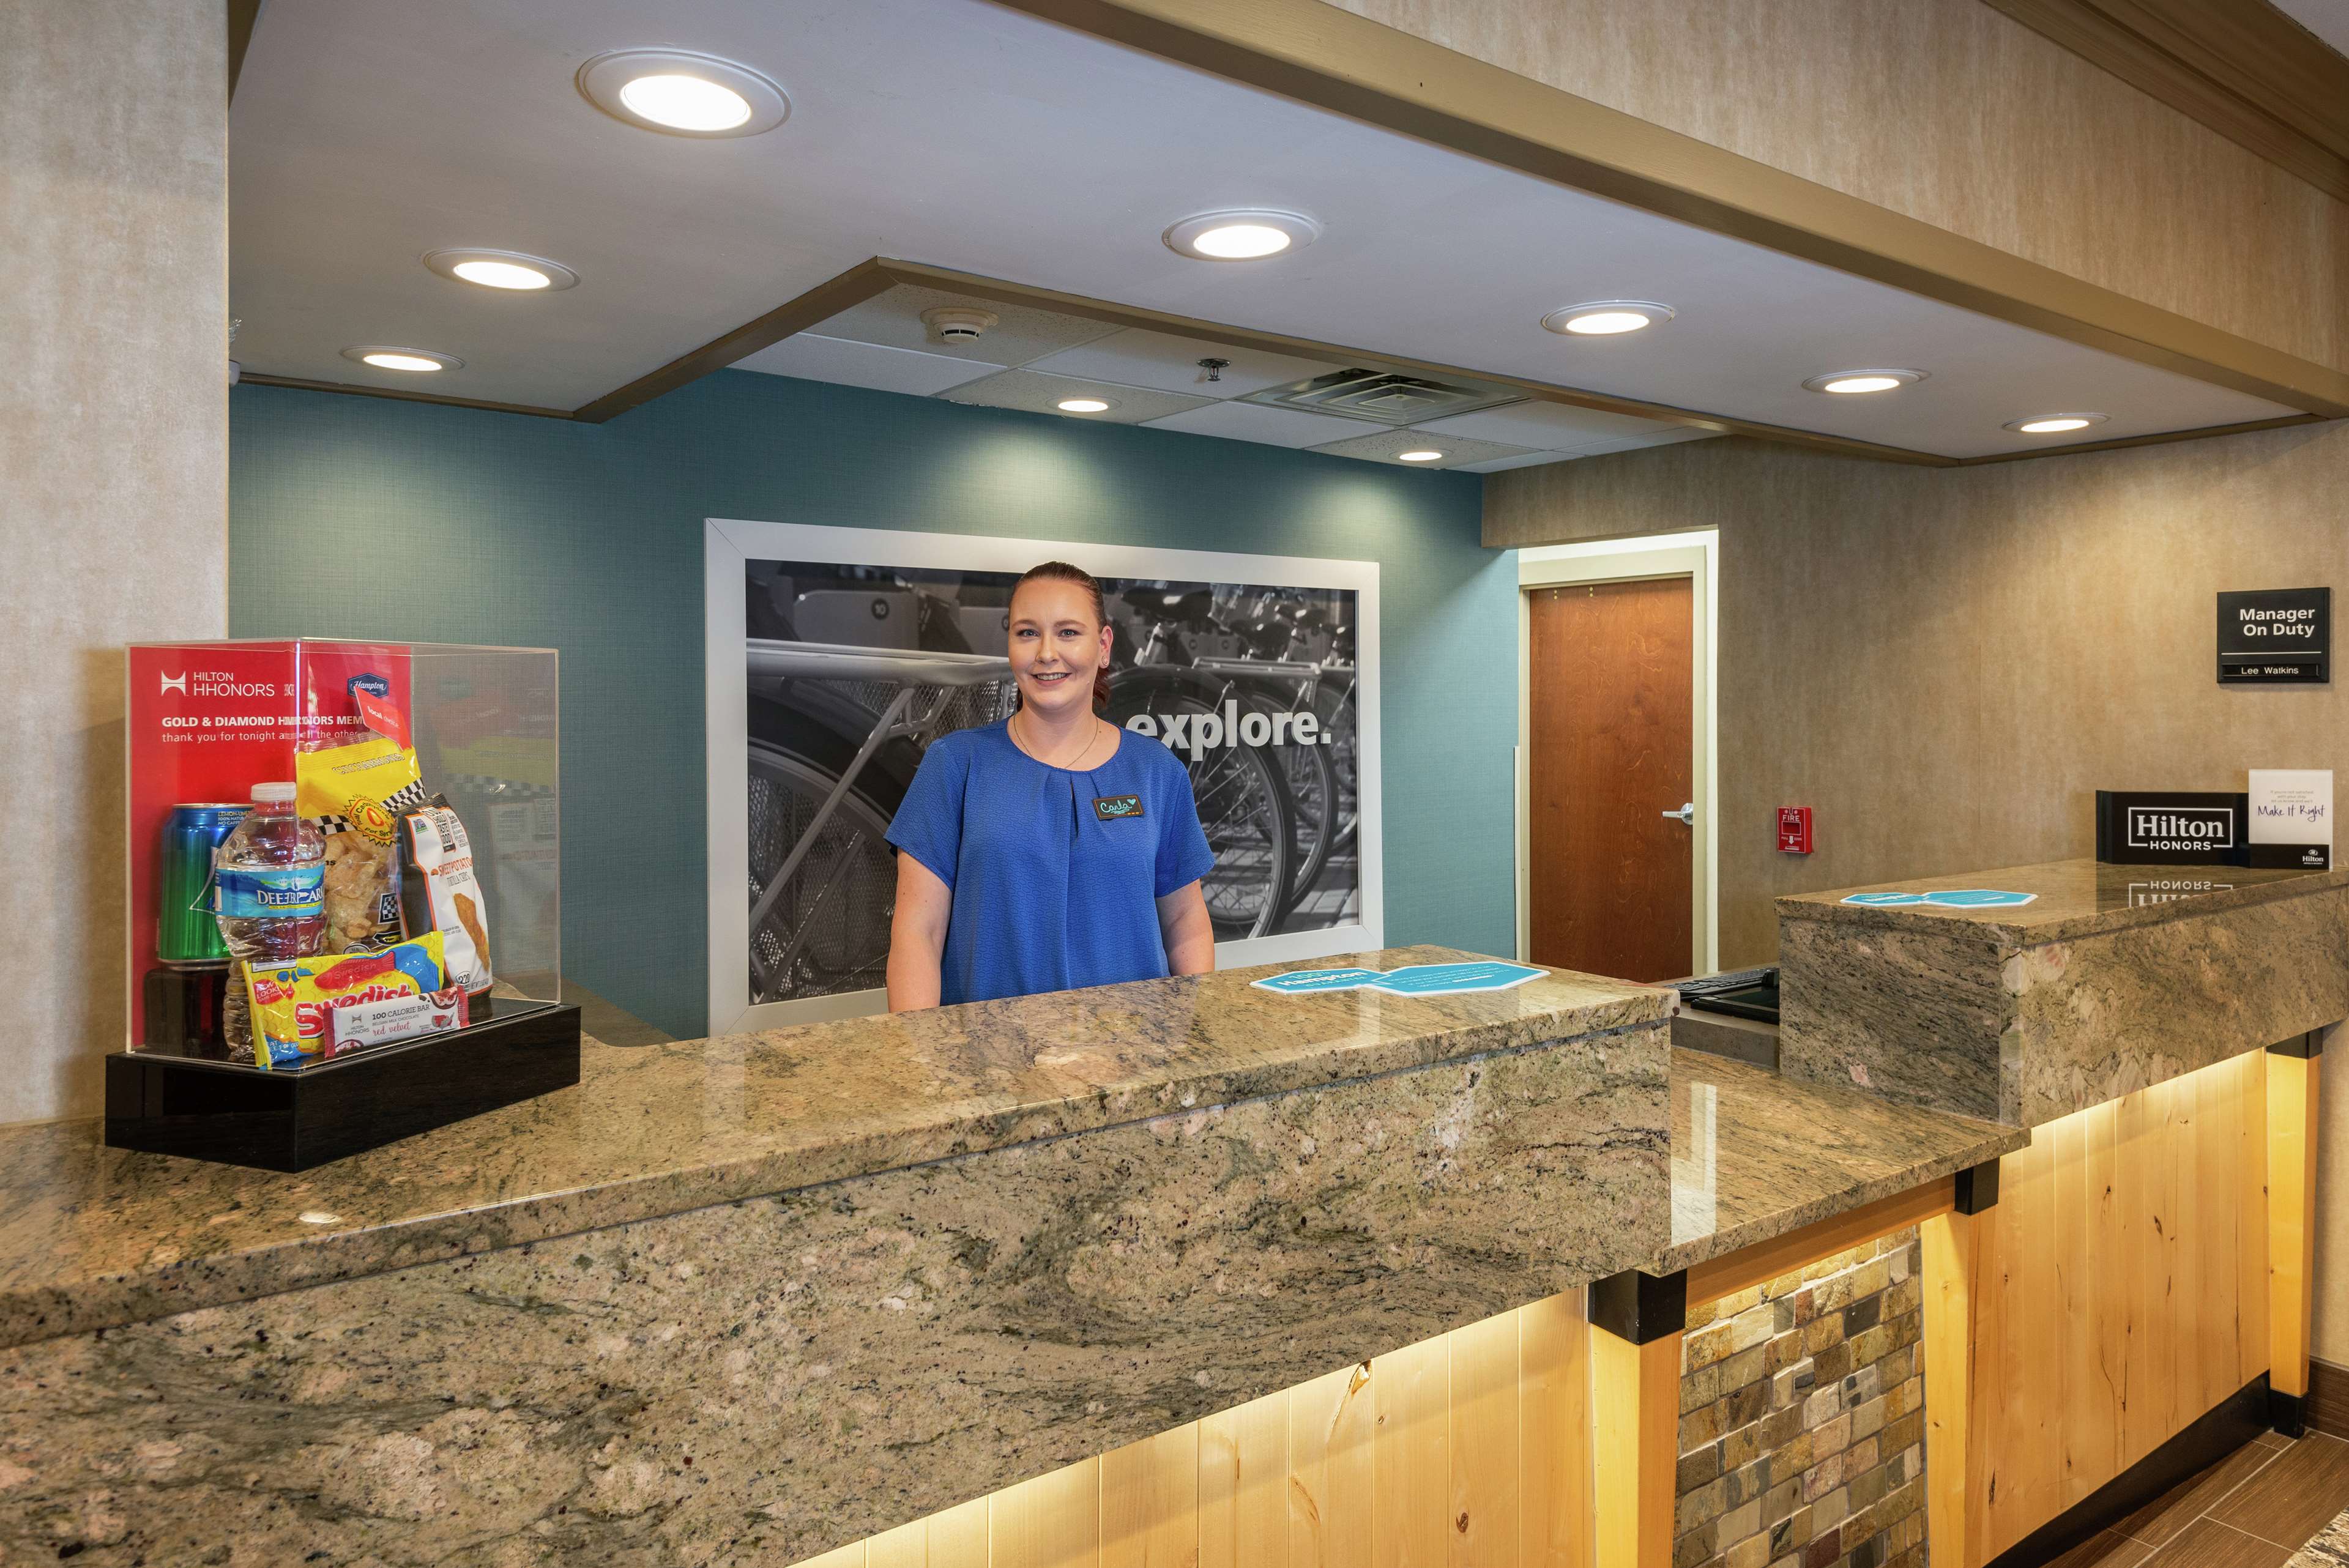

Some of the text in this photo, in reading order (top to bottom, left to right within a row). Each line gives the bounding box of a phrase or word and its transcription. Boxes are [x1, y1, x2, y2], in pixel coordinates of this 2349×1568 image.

[2239, 608, 2315, 622] Manager
[2243, 623, 2315, 637] On Duty
[193, 672, 233, 681] HILTON
[193, 683, 275, 697] HHONORS
[353, 680, 388, 692] Hampton
[162, 716, 199, 727] GOLD
[202, 716, 212, 727] &
[215, 716, 275, 726] DIAMOND
[162, 732, 193, 742] thank
[197, 734, 216, 744] you
[220, 731, 235, 741] for
[239, 730, 275, 741] tonight
[1126, 699, 1331, 762] explore.
[2258, 804, 2326, 822] Make It Right
[2137, 814, 2225, 838] Hilton
[2150, 841, 2211, 851] HONORS
[1277, 972, 1368, 986] Hampton
[372, 1012, 386, 1020] 100
[387, 1006, 417, 1017] CALORIE
[373, 1025, 386, 1036] red
[389, 1020, 411, 1033] velvet
